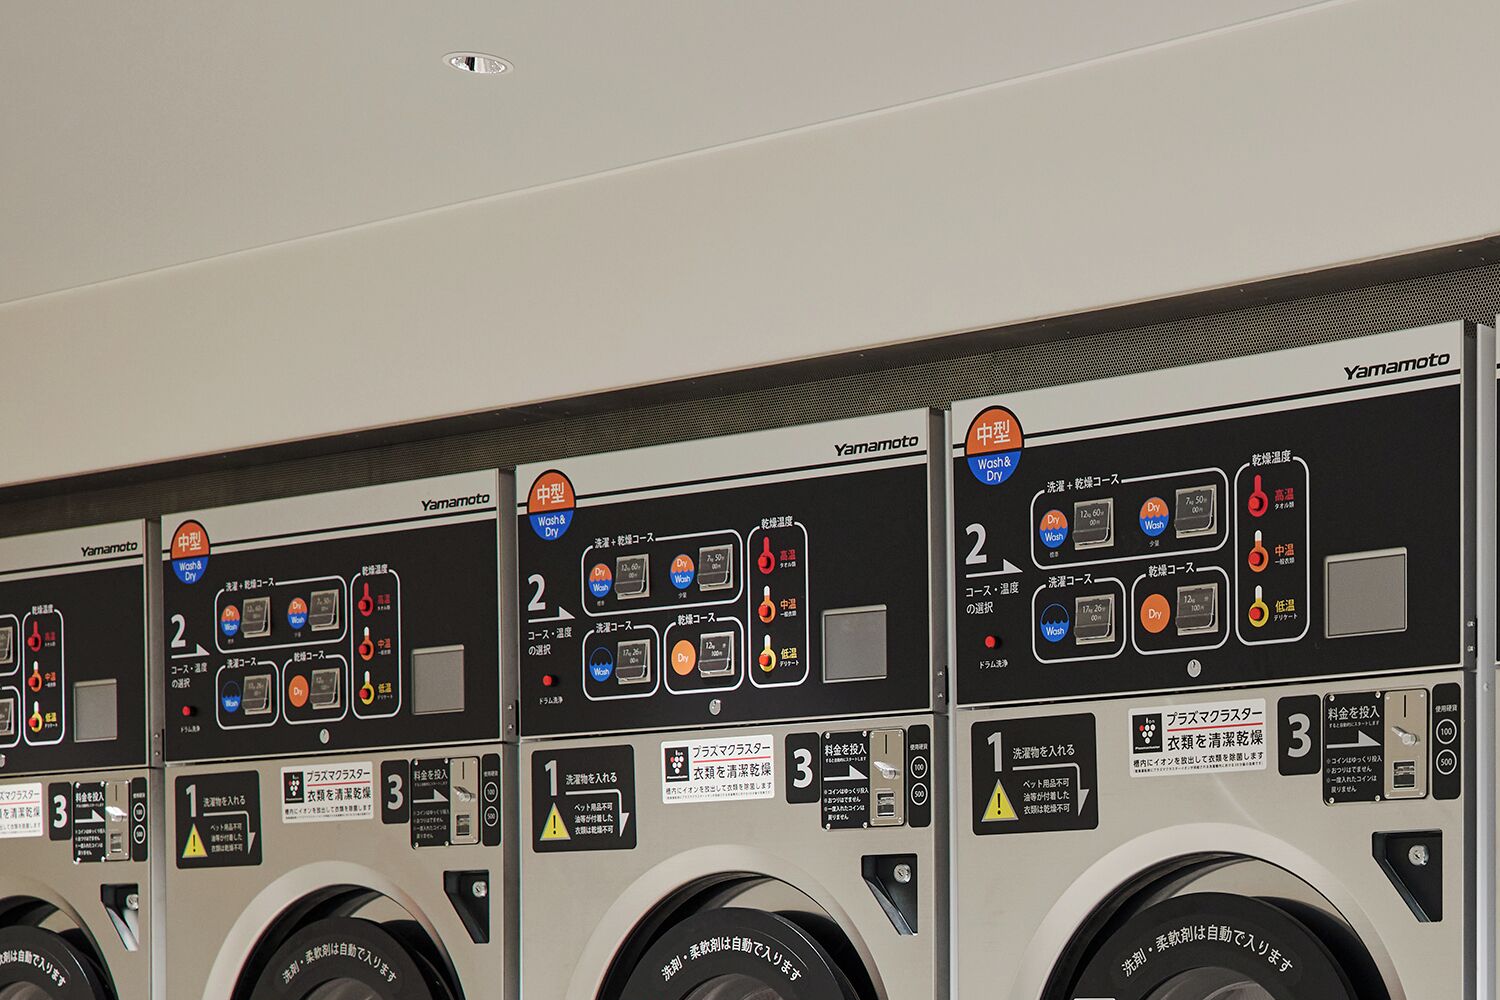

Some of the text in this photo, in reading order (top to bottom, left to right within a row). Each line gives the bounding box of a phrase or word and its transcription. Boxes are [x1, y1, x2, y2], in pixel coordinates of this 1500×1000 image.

[1344, 353, 1450, 380] Yamamoto
[977, 419, 1010, 446] 中型
[835, 436, 918, 456] Yamamoto
[1252, 450, 1291, 466] 乾燥温度
[987, 471, 1002, 482] Dry
[537, 482, 565, 505] 中型
[421, 493, 490, 511] Yamamoto
[1147, 503, 1160, 513] Dry
[1048, 515, 1059, 525] Dry
[1145, 520, 1164, 530] Wash
[546, 527, 558, 538] Dry
[1045, 532, 1063, 543] Wash
[81, 541, 138, 557] Yamamoto
[178, 532, 201, 552] 中型
[965, 523, 987, 565] 2
[1275, 543, 1294, 557] 中温
[1149, 562, 1195, 577] 乾燥コース
[1048, 574, 1092, 588] 洗濯コース
[528, 574, 545, 611] 2
[966, 582, 1019, 597] コース・温度
[966, 602, 993, 614] の選択
[1275, 599, 1295, 613] 低温
[678, 613, 715, 626] 乾燥コース
[1149, 609, 1162, 620] Dry
[171, 614, 186, 648] 2
[528, 627, 572, 640] コース・温度
[596, 621, 632, 633] 洗濯コース
[1046, 627, 1065, 636] Wash
[528, 644, 551, 656] の選択
[1167, 708, 1262, 726] プラズマクラスター
[1328, 706, 1380, 721] 料金を投入
[1288, 713, 1312, 757] 3
[1440, 727, 1452, 736] 100
[1168, 730, 1263, 751] 衣類を清潔乾燥
[693, 743, 770, 758] プラズマクラスター
[824, 743, 867, 756] 料金を投入
[987, 732, 1002, 772] 1
[1013, 744, 1075, 759] 洗濯物を入れる
[793, 748, 813, 788] 3
[1440, 758, 1452, 767] 500
[545, 760, 557, 796] 1
[566, 772, 617, 785] 洗濯物を入れる
[694, 762, 771, 780] 衣類を清潔乾燥
[1023, 778, 1069, 788] ペット用品不可
[387, 774, 404, 810] 3
[186, 784, 196, 818] 1
[53, 794, 68, 829] 3
[1024, 804, 1070, 815] 衣類は乾燥不可
[1121, 924, 1293, 977] 洗剤・柔軟剤は自動で入ります
[281, 942, 398, 985] 洗剤・柔軟剤は自動で入ります
[661, 936, 802, 982] 洗剤・柔軟剤は自動で入ります
